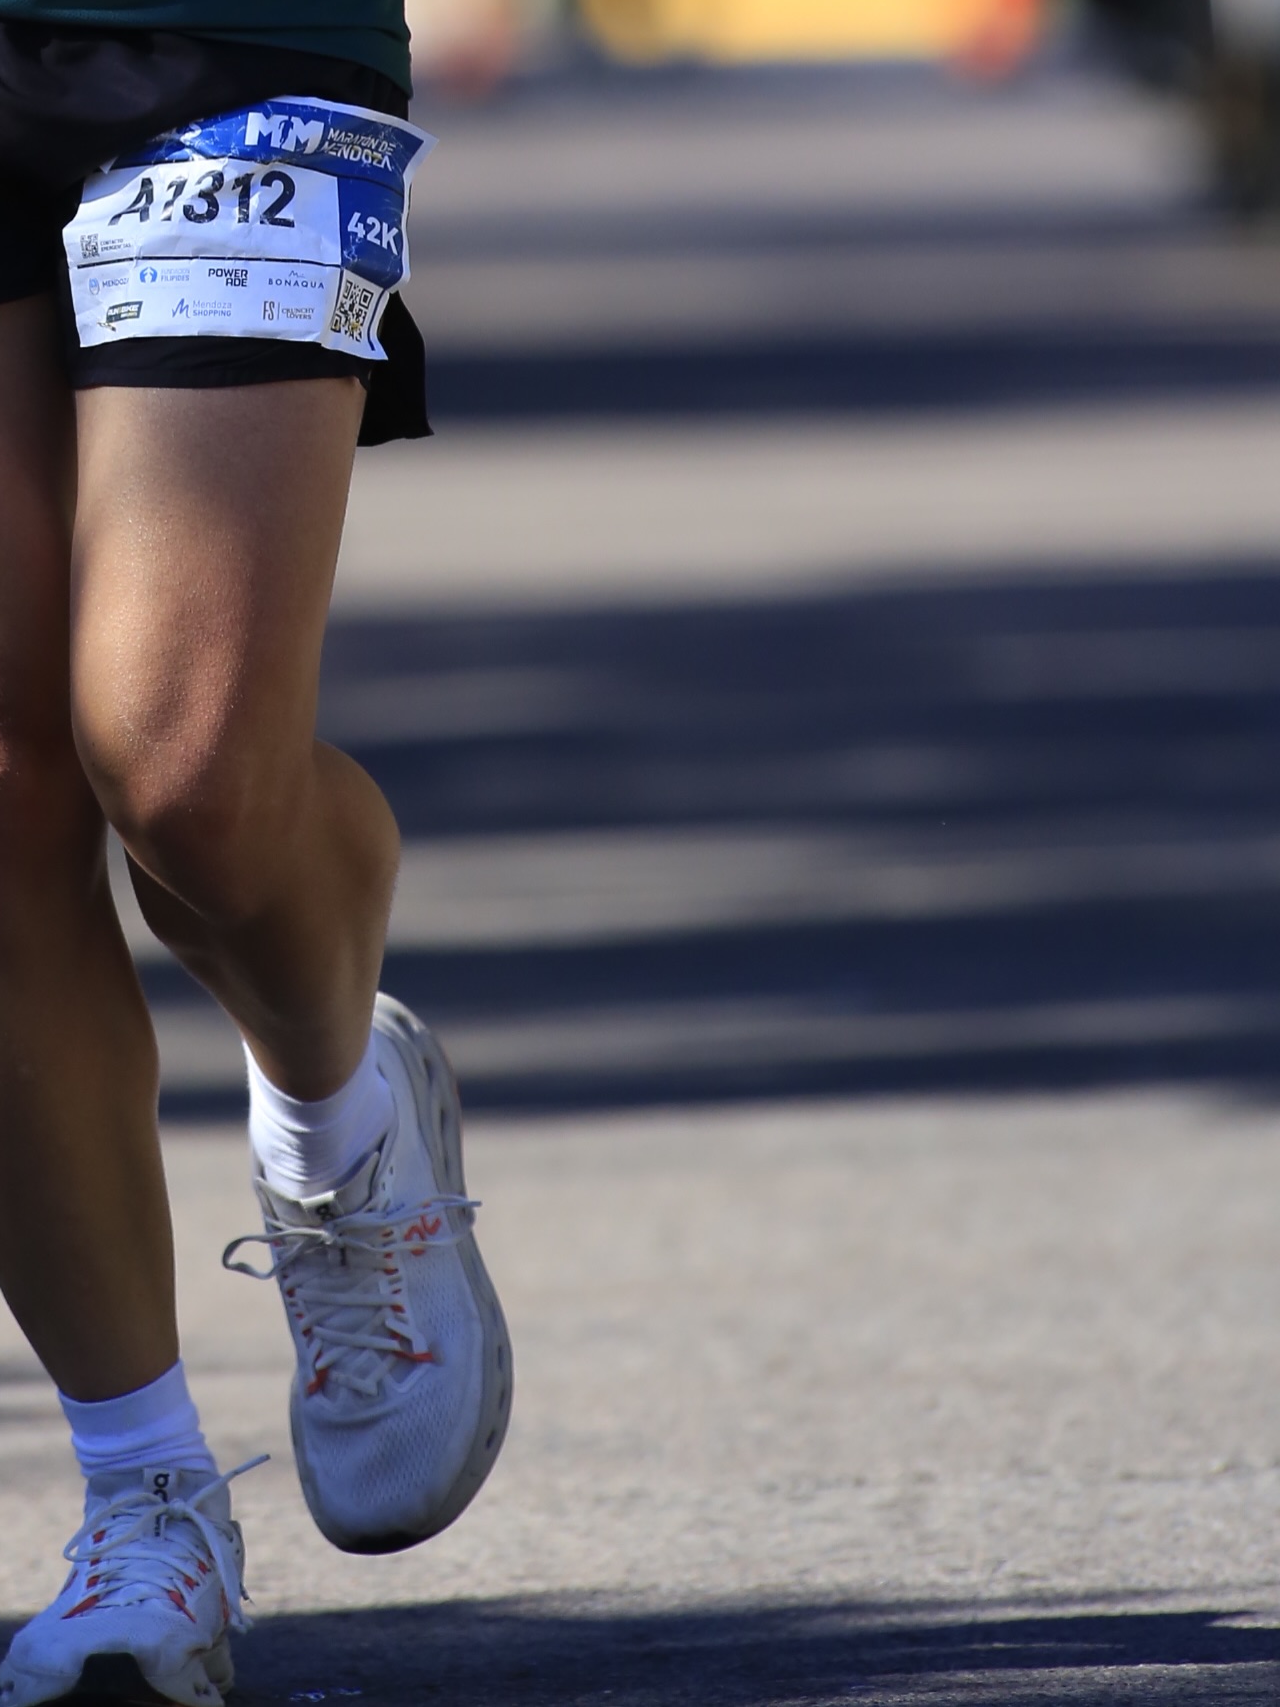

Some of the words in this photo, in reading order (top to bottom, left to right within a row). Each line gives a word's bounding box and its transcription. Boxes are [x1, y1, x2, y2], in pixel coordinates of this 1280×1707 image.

[378, 139, 397, 156] DE
[320, 141, 392, 172] MENDOZA
[107, 169, 296, 228] A1312
[347, 211, 401, 256] 42K
[208, 268, 249, 279] POWER
[225, 277, 248, 288] ADE
[268, 278, 325, 289] BONAQUA
[192, 300, 232, 309] Mendoza
[192, 309, 232, 317] SHOPPING
[263, 300, 275, 321] FS
[286, 312, 312, 320] LOVERS
